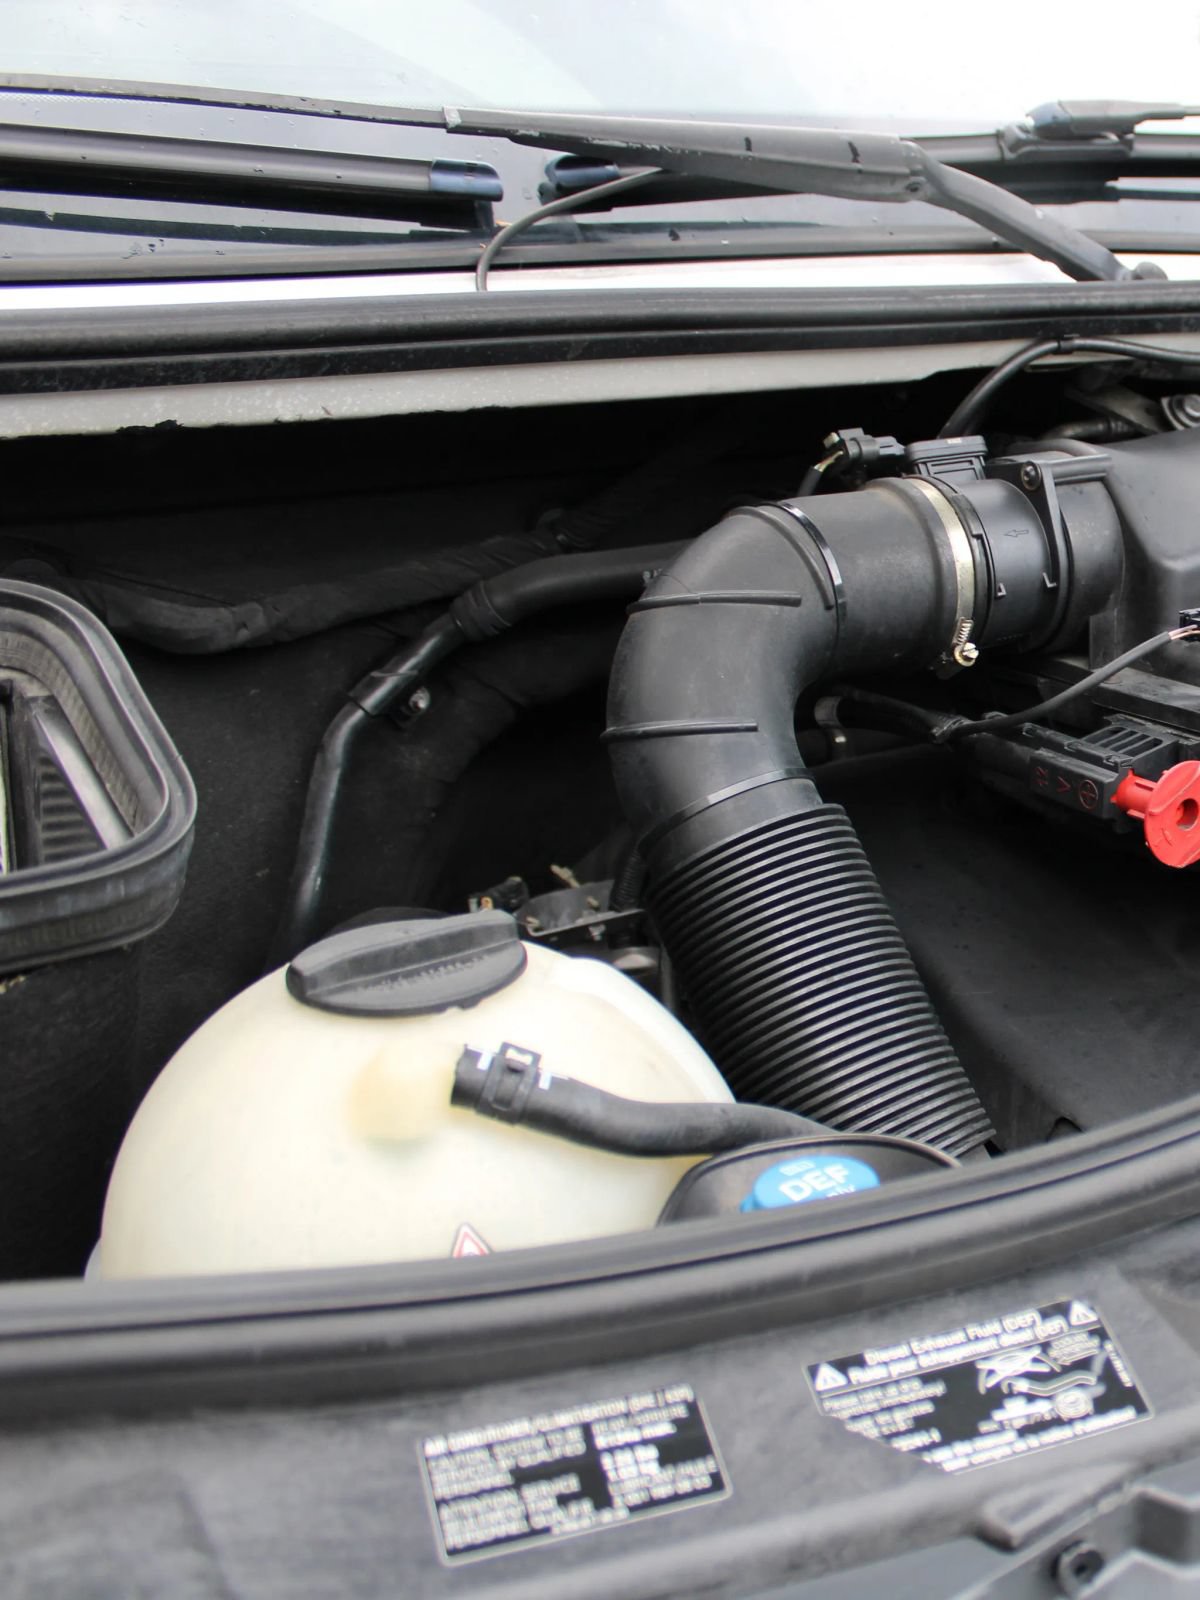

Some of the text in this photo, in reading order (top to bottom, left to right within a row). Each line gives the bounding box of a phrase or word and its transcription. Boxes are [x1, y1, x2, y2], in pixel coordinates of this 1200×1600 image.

[777, 1163, 848, 1202] DEF
[864, 1308, 1042, 1365] Diesel Exhaust Fluid (DEF)
[1034, 1315, 1070, 1341] (DEF)
